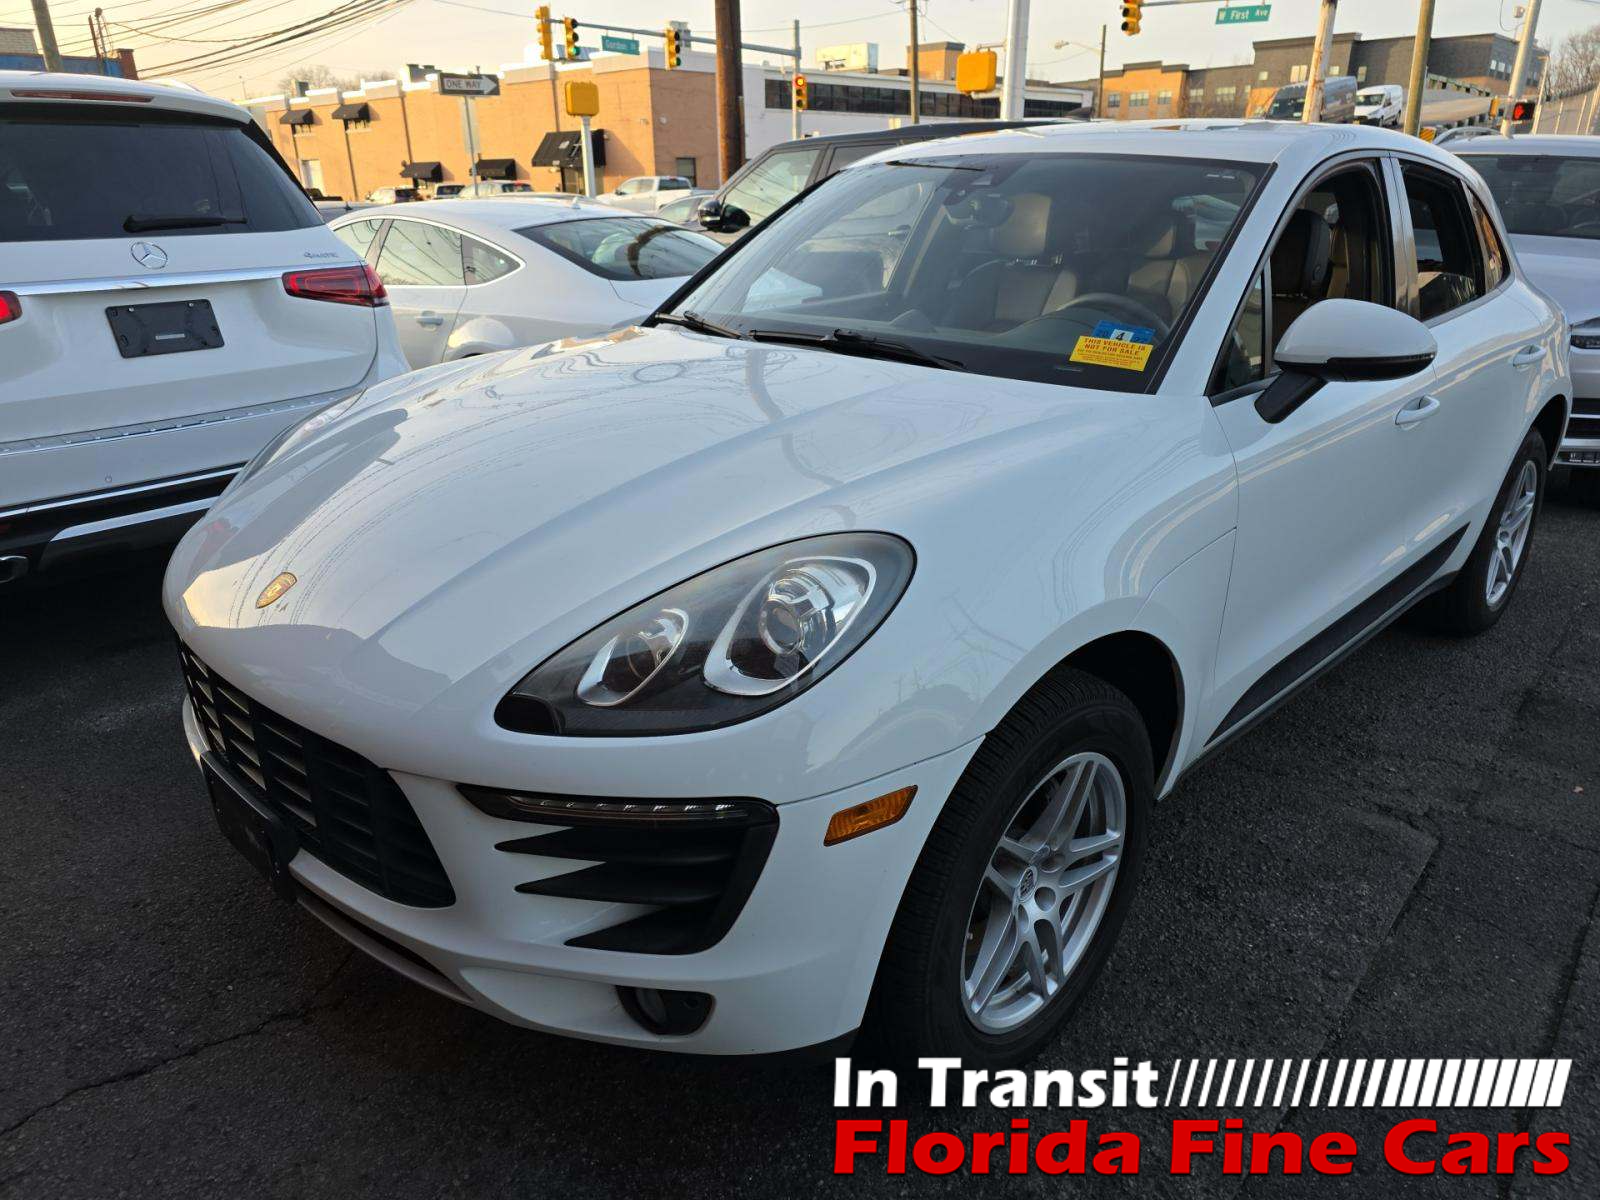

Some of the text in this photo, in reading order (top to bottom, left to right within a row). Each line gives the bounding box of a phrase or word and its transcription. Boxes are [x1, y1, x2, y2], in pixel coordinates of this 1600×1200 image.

[1230, 10, 1249, 20] First
[1255, 9, 1270, 17] Ave
[446, 79, 481, 89] ONE WAY
[1115, 332, 1126, 342] 4
[1085, 337, 1101, 345] THIS
[1103, 339, 1136, 350] VEHICLE
[1102, 346, 1118, 354] FOR
[1119, 348, 1140, 356] SALE
